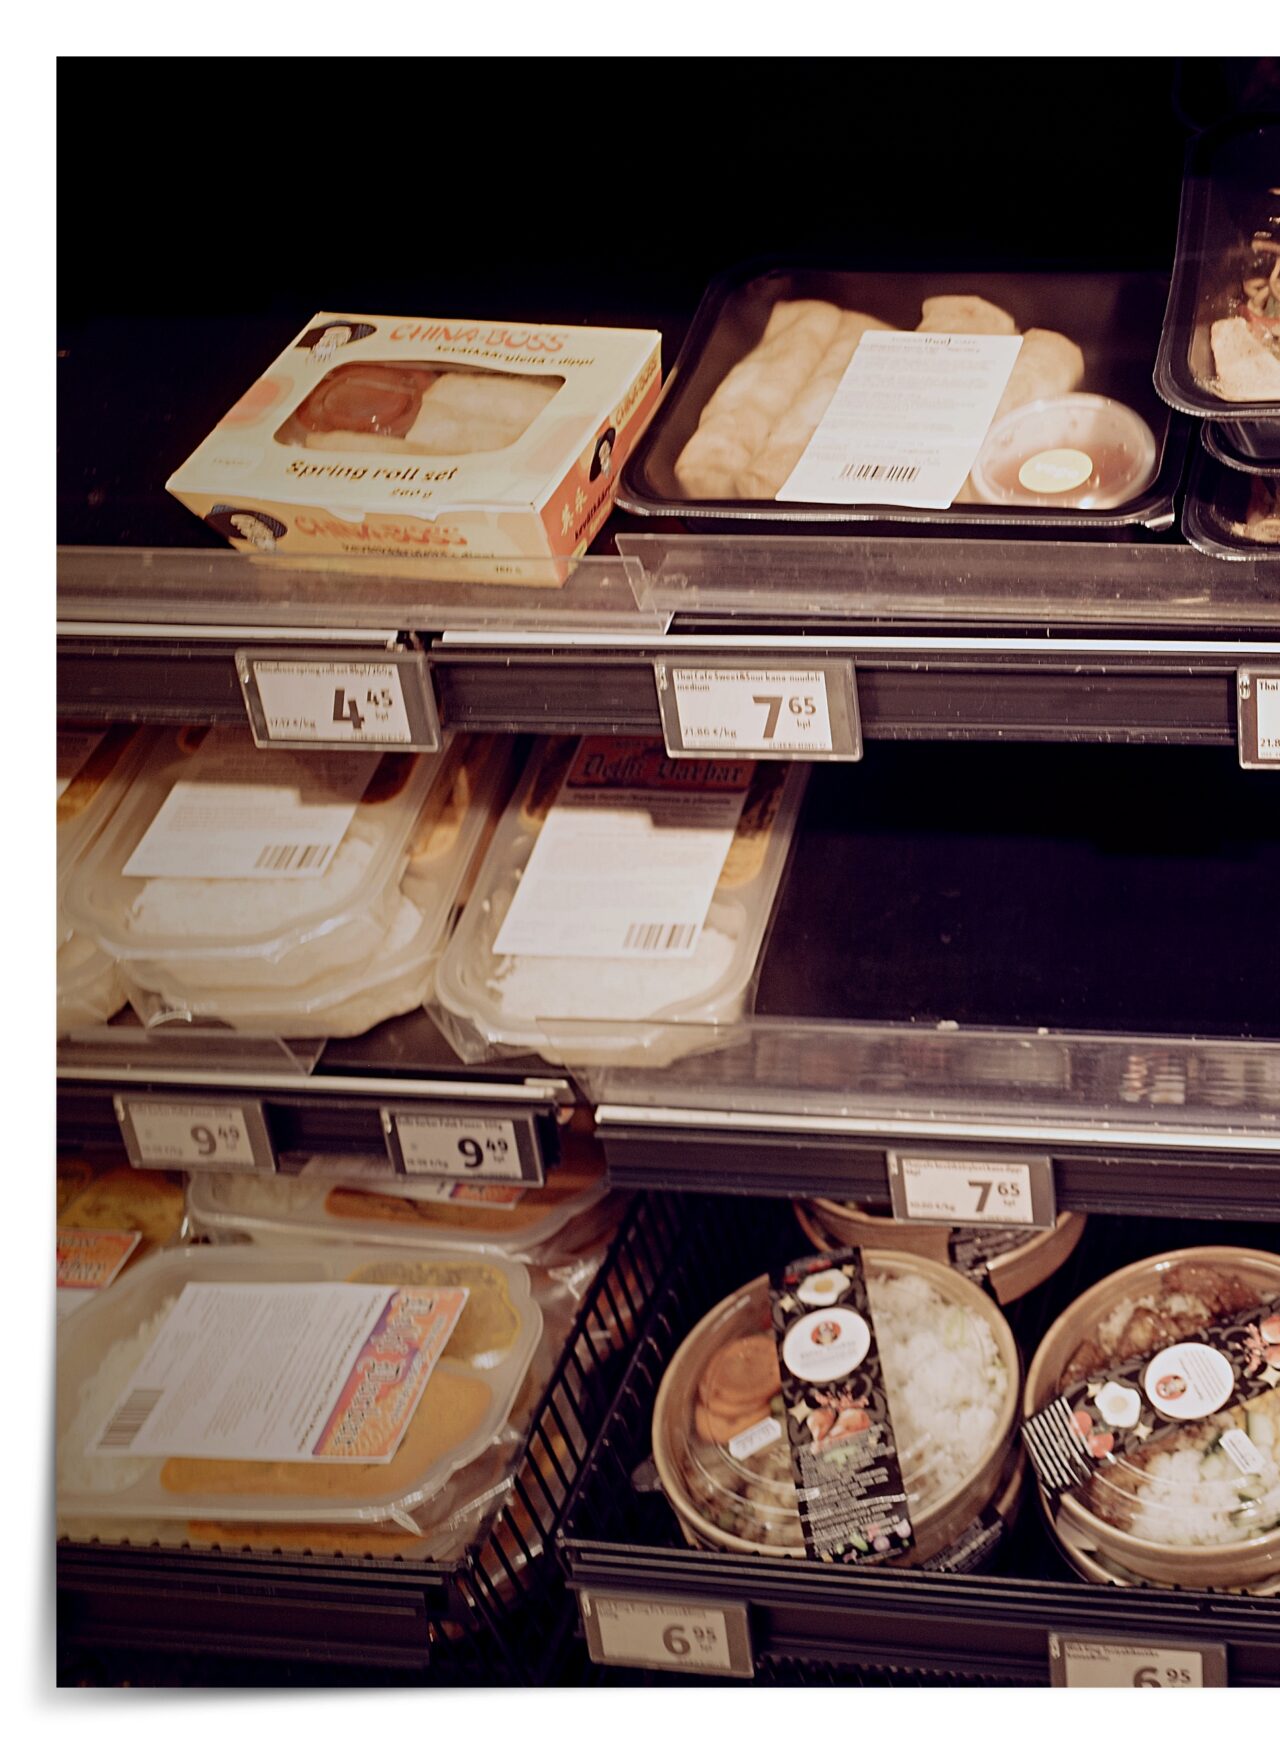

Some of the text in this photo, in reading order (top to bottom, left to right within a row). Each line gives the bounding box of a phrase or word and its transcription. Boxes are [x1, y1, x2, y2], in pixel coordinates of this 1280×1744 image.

[286, 459, 459, 482] Spring roll set
[1259, 681, 1279, 692] Thai
[332, 687, 394, 730] 4 45
[752, 695, 817, 740] 7 65
[796, 719, 812, 731] kpl
[190, 1124, 217, 1155] 9
[457, 1137, 509, 1169] 9 49
[967, 1179, 1021, 1214] 7 65
[662, 1623, 691, 1656] 6
[1166, 1668, 1191, 1684] 95
